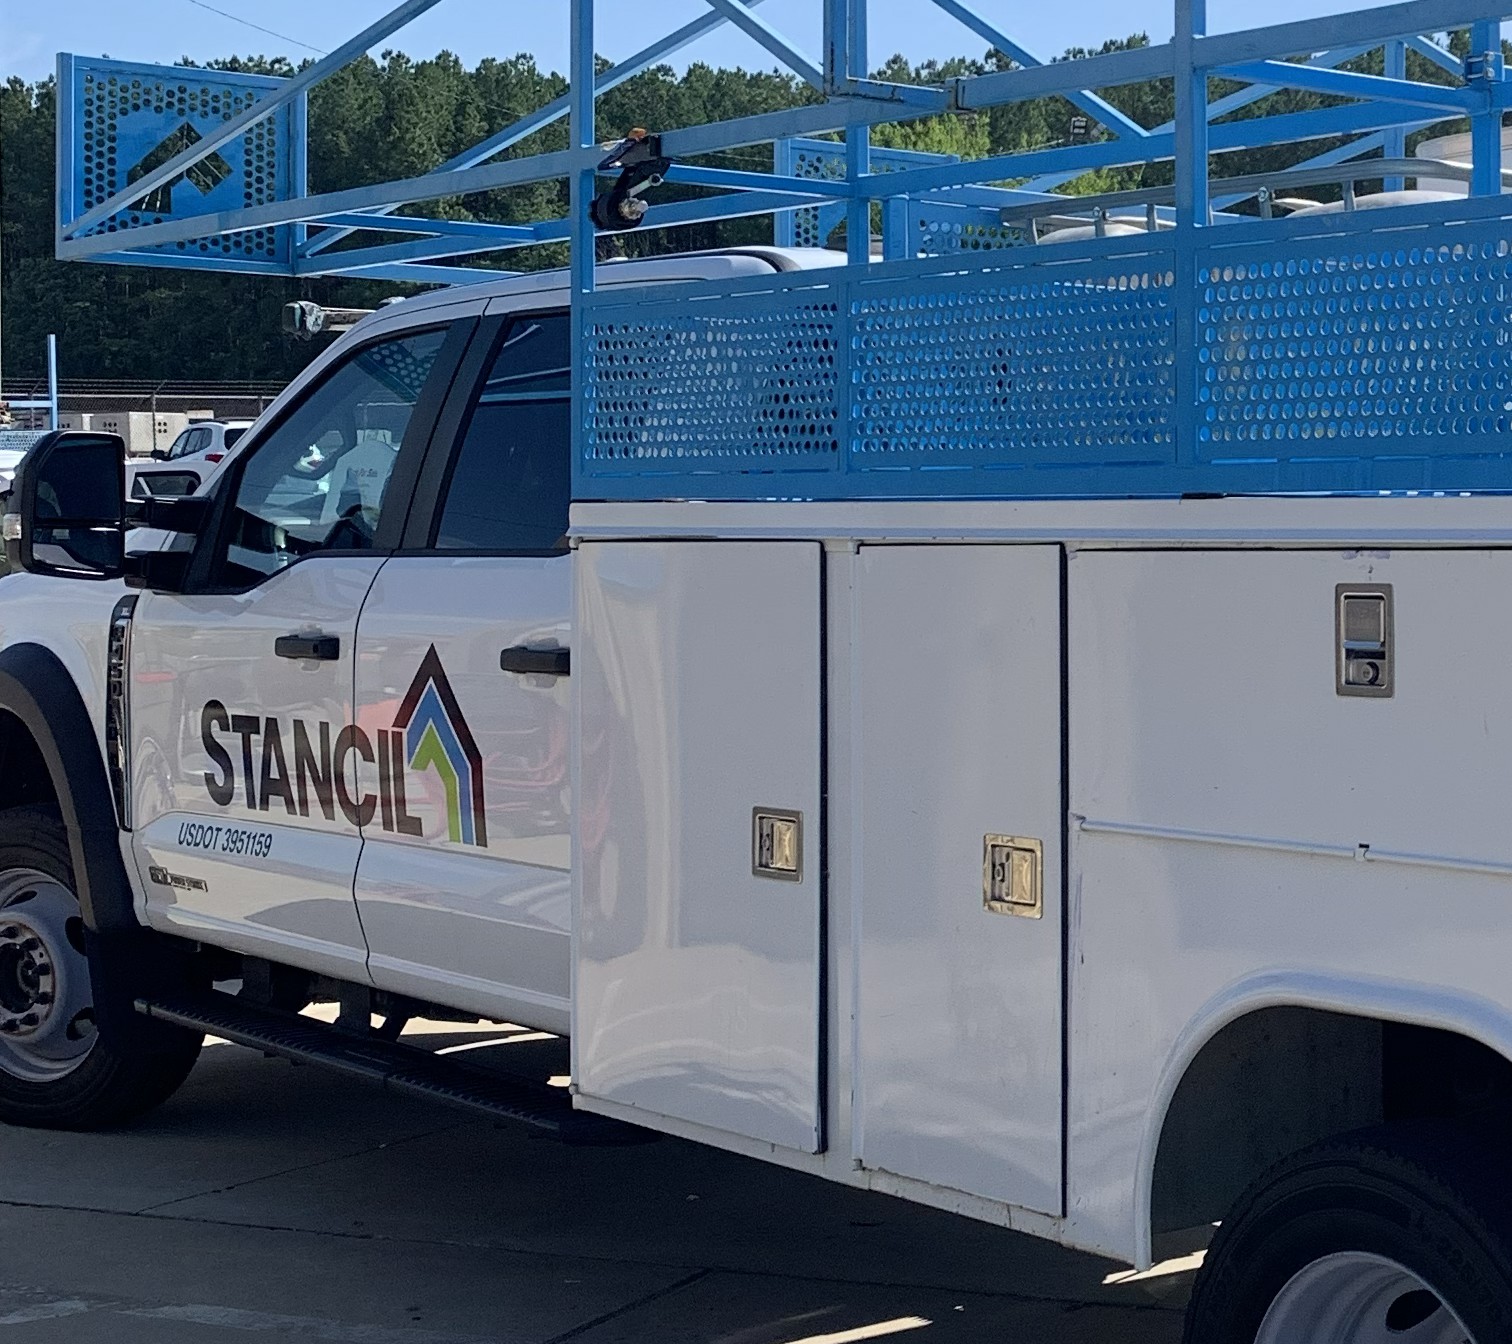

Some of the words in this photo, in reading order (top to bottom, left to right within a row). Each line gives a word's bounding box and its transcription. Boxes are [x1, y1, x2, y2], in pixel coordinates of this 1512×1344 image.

[201, 699, 424, 837] STANCIL
[178, 822, 223, 851] USDOT
[221, 828, 273, 858] 3951159
